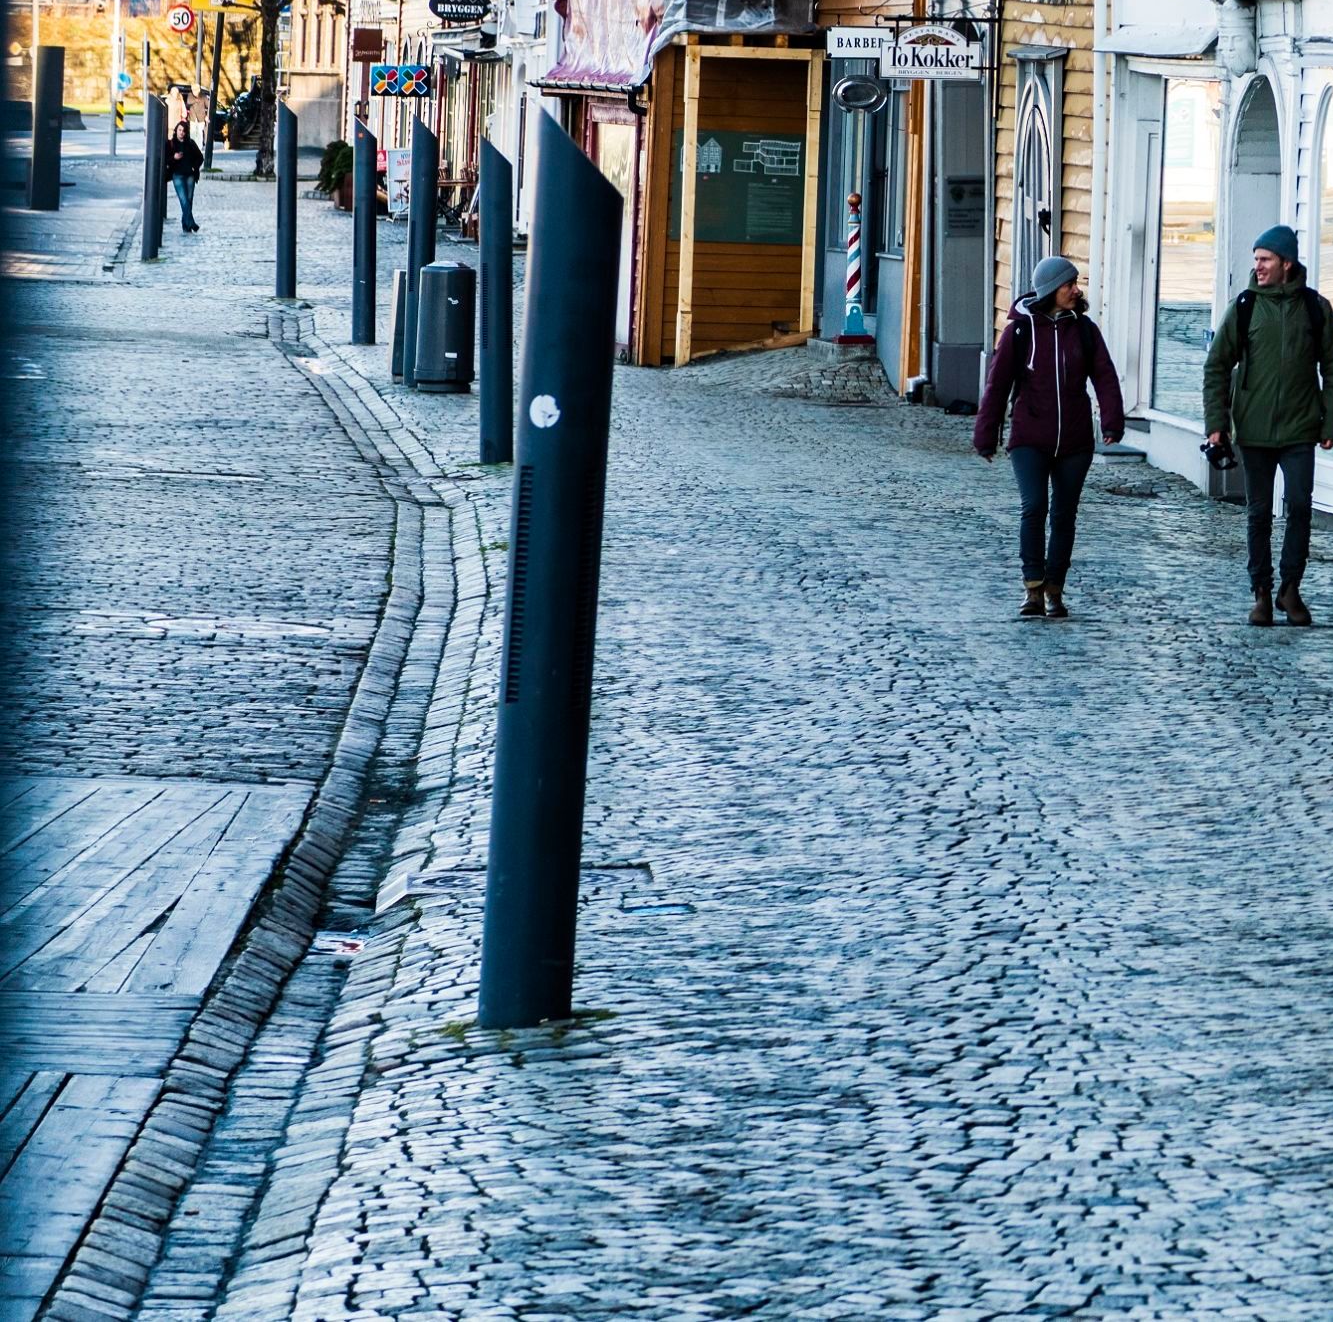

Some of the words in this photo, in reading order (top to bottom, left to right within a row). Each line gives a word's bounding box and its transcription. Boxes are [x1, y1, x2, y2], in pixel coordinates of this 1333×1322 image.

[437, 3, 484, 15] BRYGGEN
[173, 12, 190, 26] 50
[888, 47, 908, 67] To
[911, 47, 974, 68] Kokker
